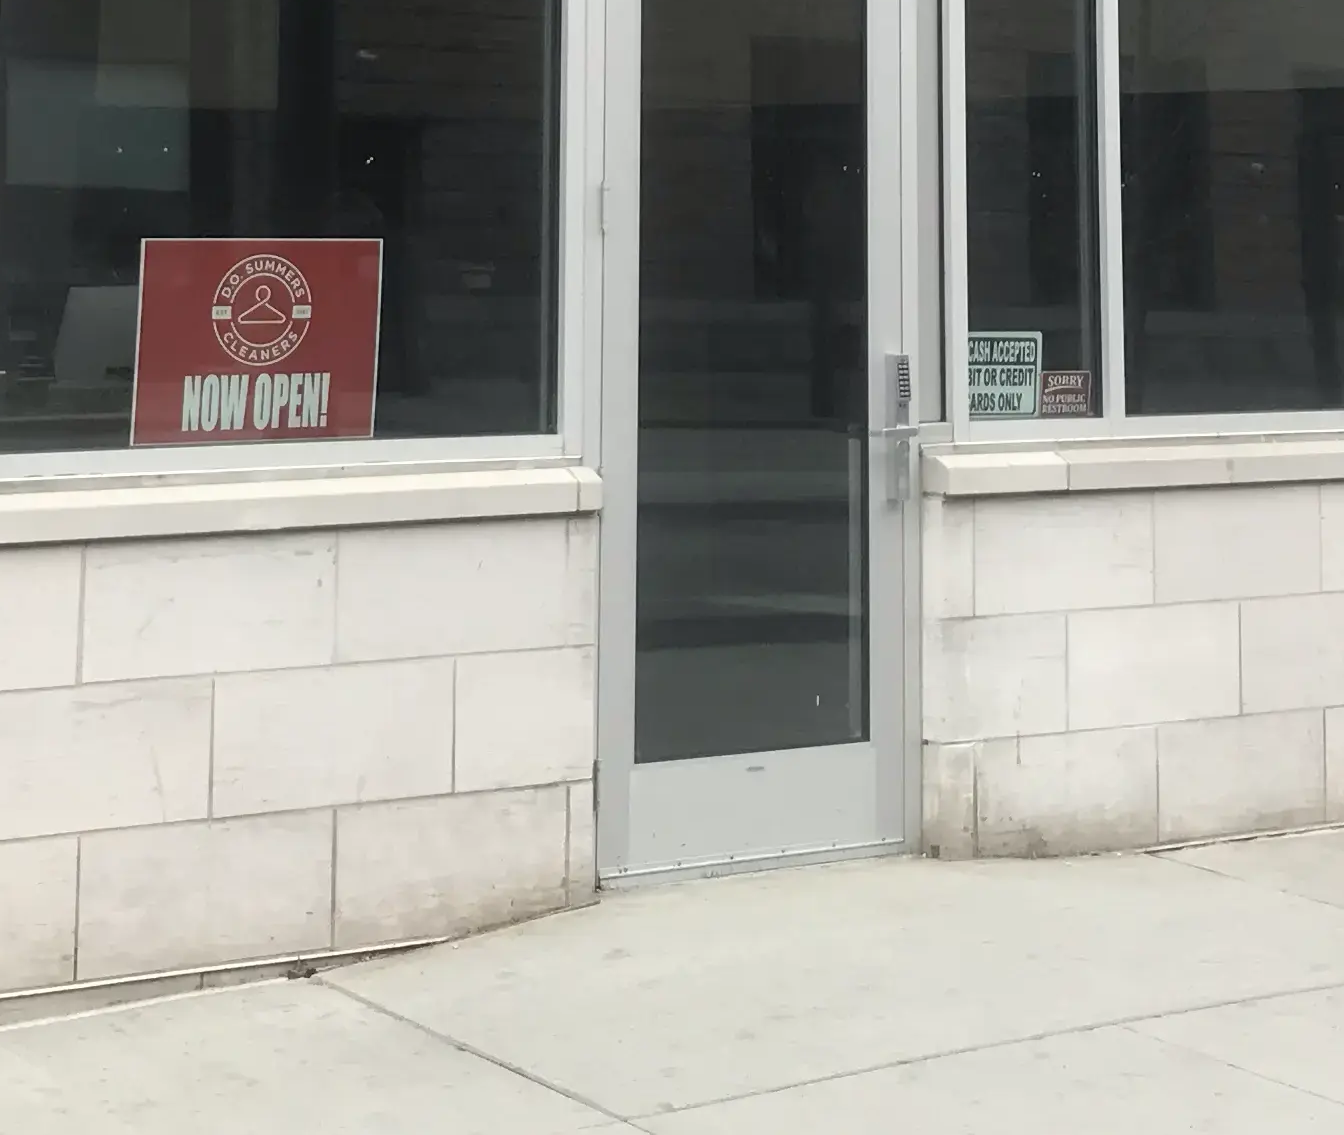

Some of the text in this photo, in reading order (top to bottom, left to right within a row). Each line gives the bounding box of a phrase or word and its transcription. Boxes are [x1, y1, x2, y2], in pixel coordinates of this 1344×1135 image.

[245, 260, 305, 298] SUMMERS
[223, 331, 298, 361] CLEANERS
[968, 340, 1036, 363] CASH ACCEPTED
[983, 368, 997, 387] OR
[999, 368, 1034, 387] CREDIT
[1048, 375, 1084, 387] SORRY
[181, 372, 331, 432] NOW OPEN!
[968, 392, 1023, 412] ARDS ONLY
[1042, 393, 1086, 404] NO PUBLIC
